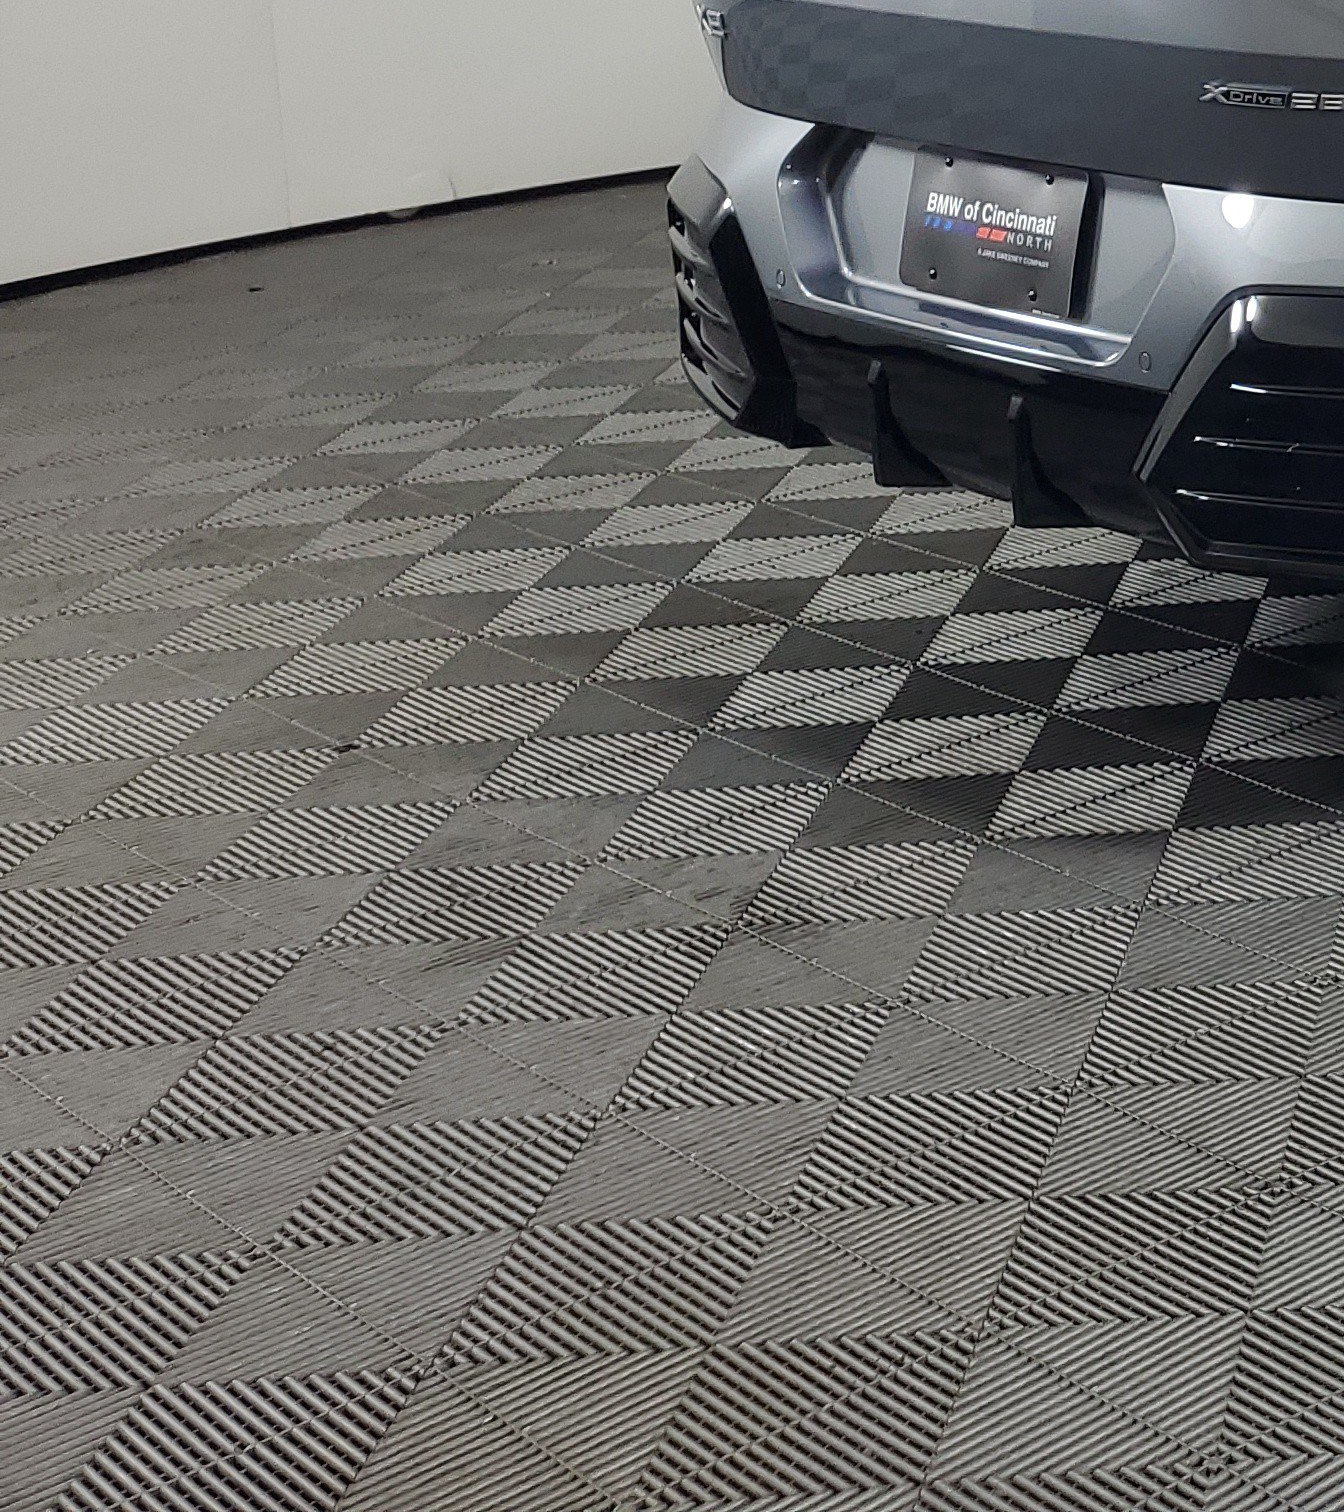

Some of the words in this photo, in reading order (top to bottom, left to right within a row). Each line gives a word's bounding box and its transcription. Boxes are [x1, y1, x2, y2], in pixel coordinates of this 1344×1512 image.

[926, 192, 964, 218] BMW
[964, 200, 981, 222] of
[981, 201, 1057, 236] Cincinnati
[1006, 231, 1053, 252] NORTH
